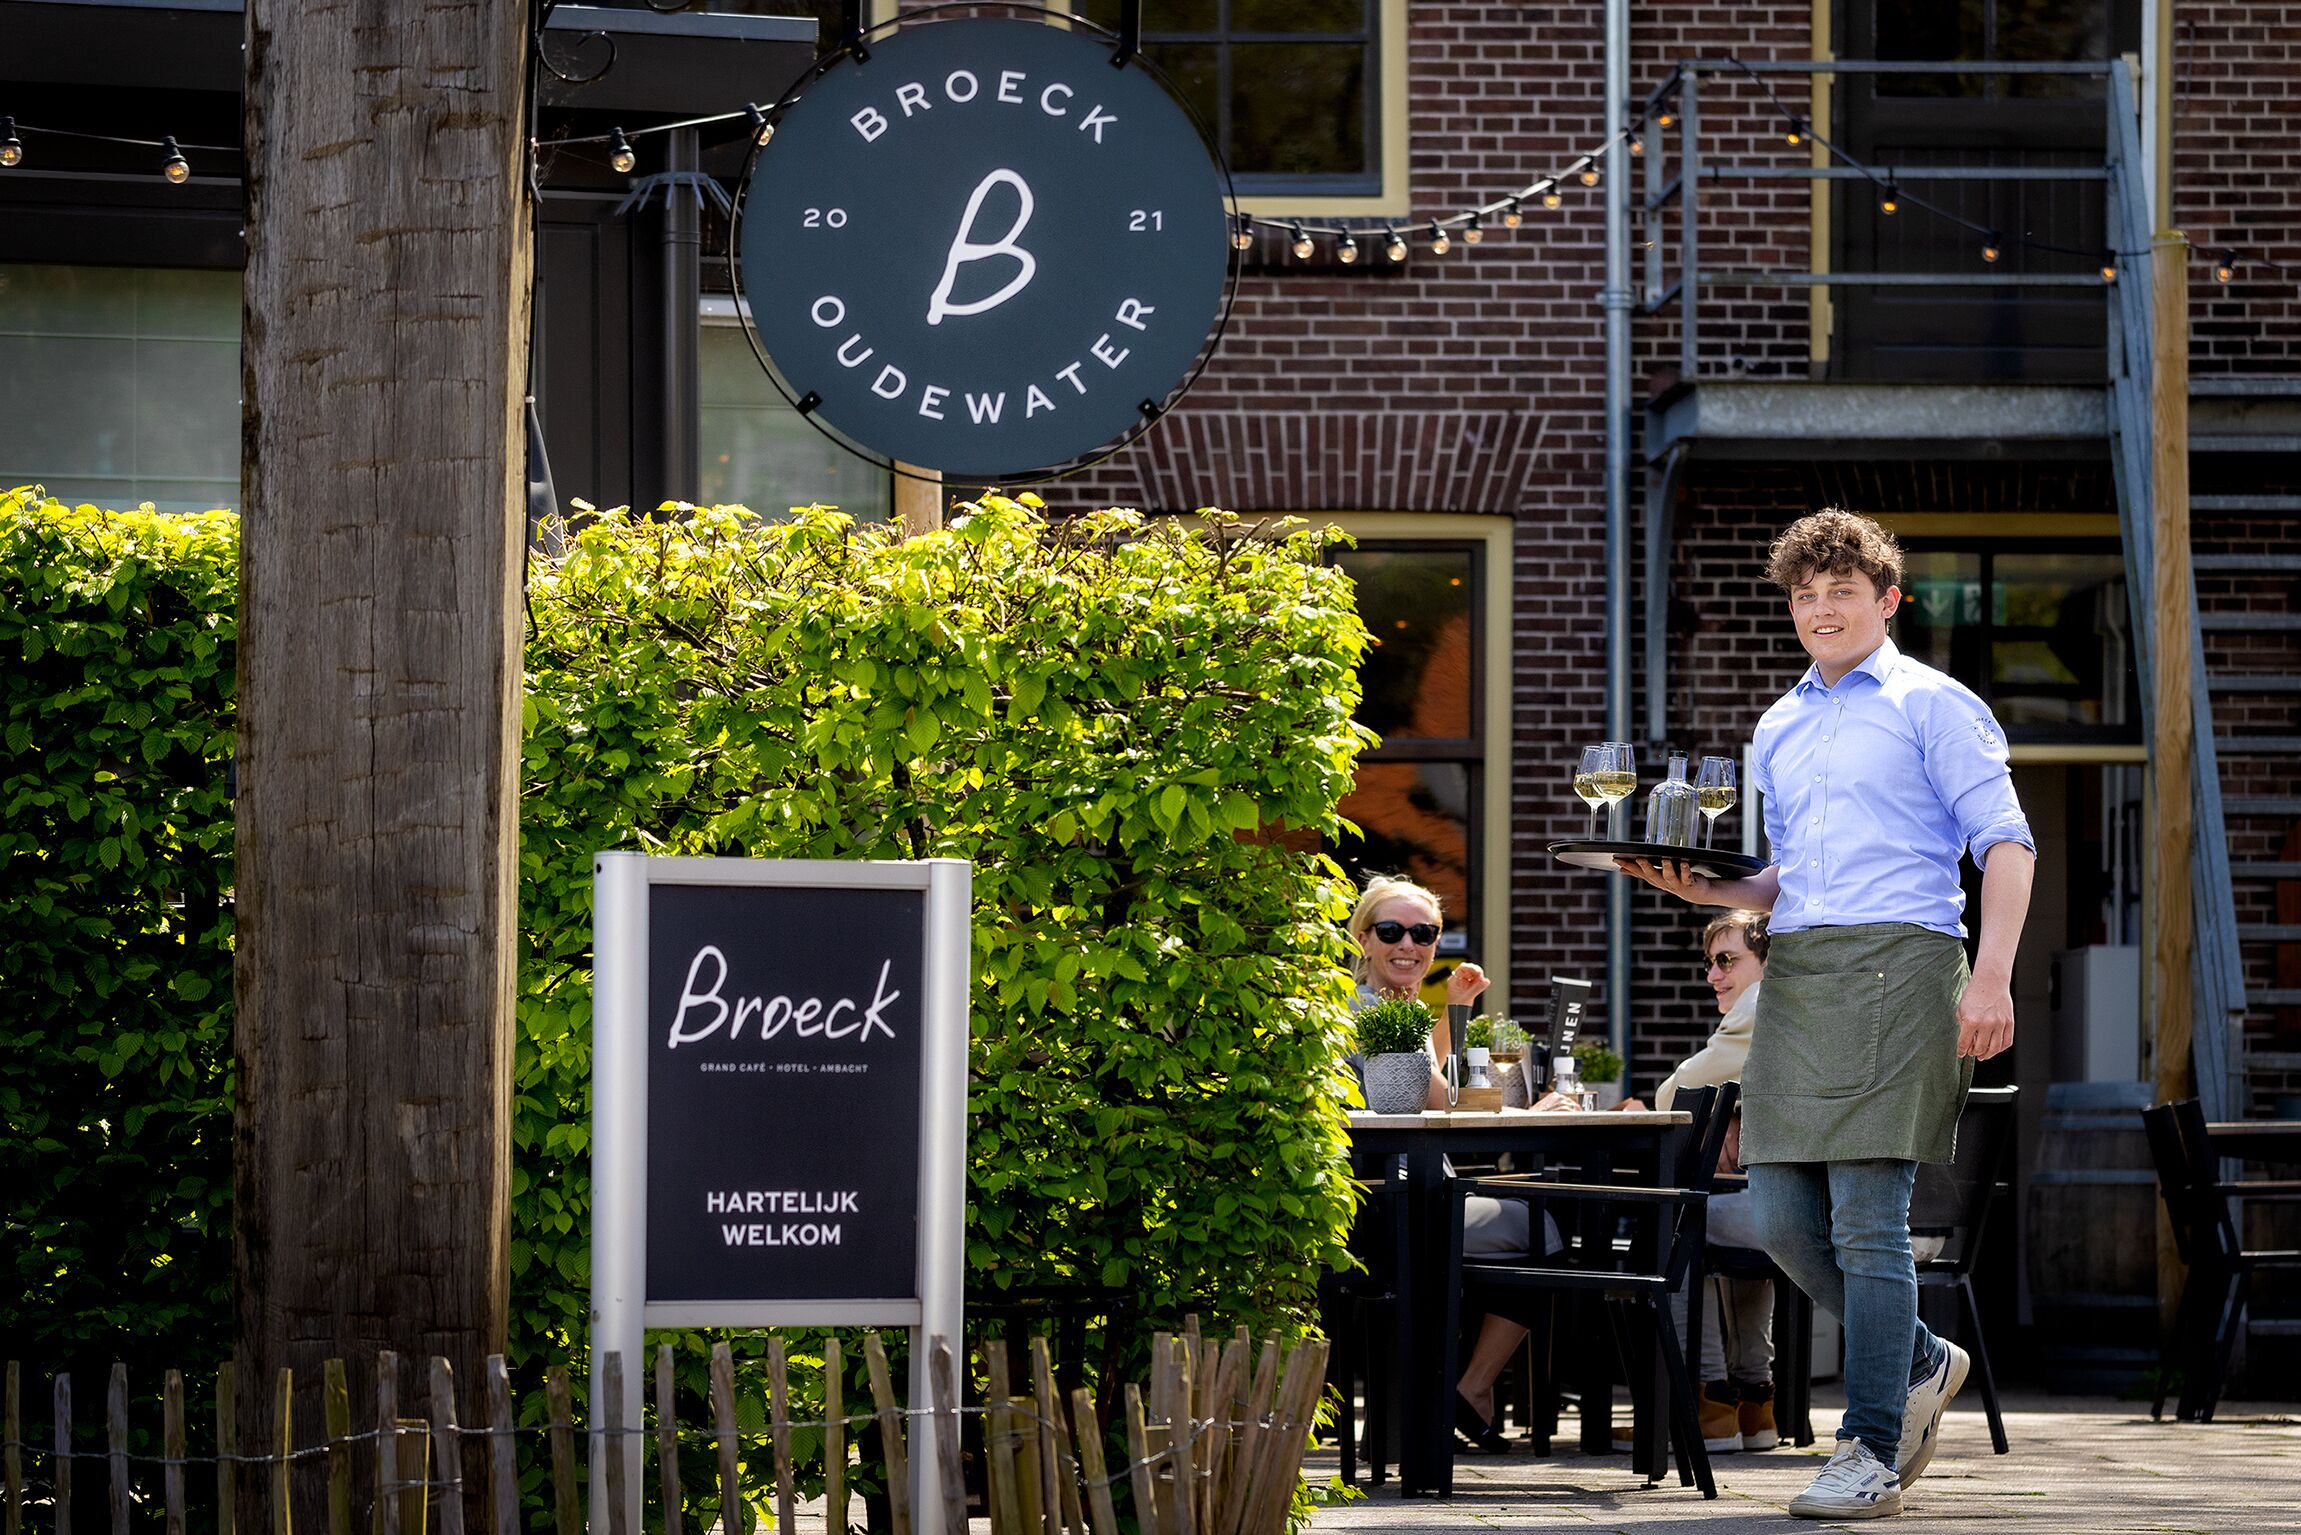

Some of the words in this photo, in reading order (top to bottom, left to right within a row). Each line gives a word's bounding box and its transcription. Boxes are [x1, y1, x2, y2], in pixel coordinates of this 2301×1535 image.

[850, 70, 1118, 144] BROECK
[803, 208, 848, 229] 20
[1128, 210, 1163, 232] 21
[927, 168, 1037, 326] B
[811, 295, 1156, 425] OUDEWATER
[667, 945, 901, 1050] Broeck
[1560, 1002, 1582, 1055] JNEN
[700, 1062, 737, 1073] GRAND
[739, 1061, 766, 1073] CAFÉ
[776, 1063, 810, 1073] HOTEL
[819, 1063, 869, 1074] AMBACHT
[707, 1191, 860, 1213] HARTELIJK
[721, 1223, 842, 1246] WELKOM
